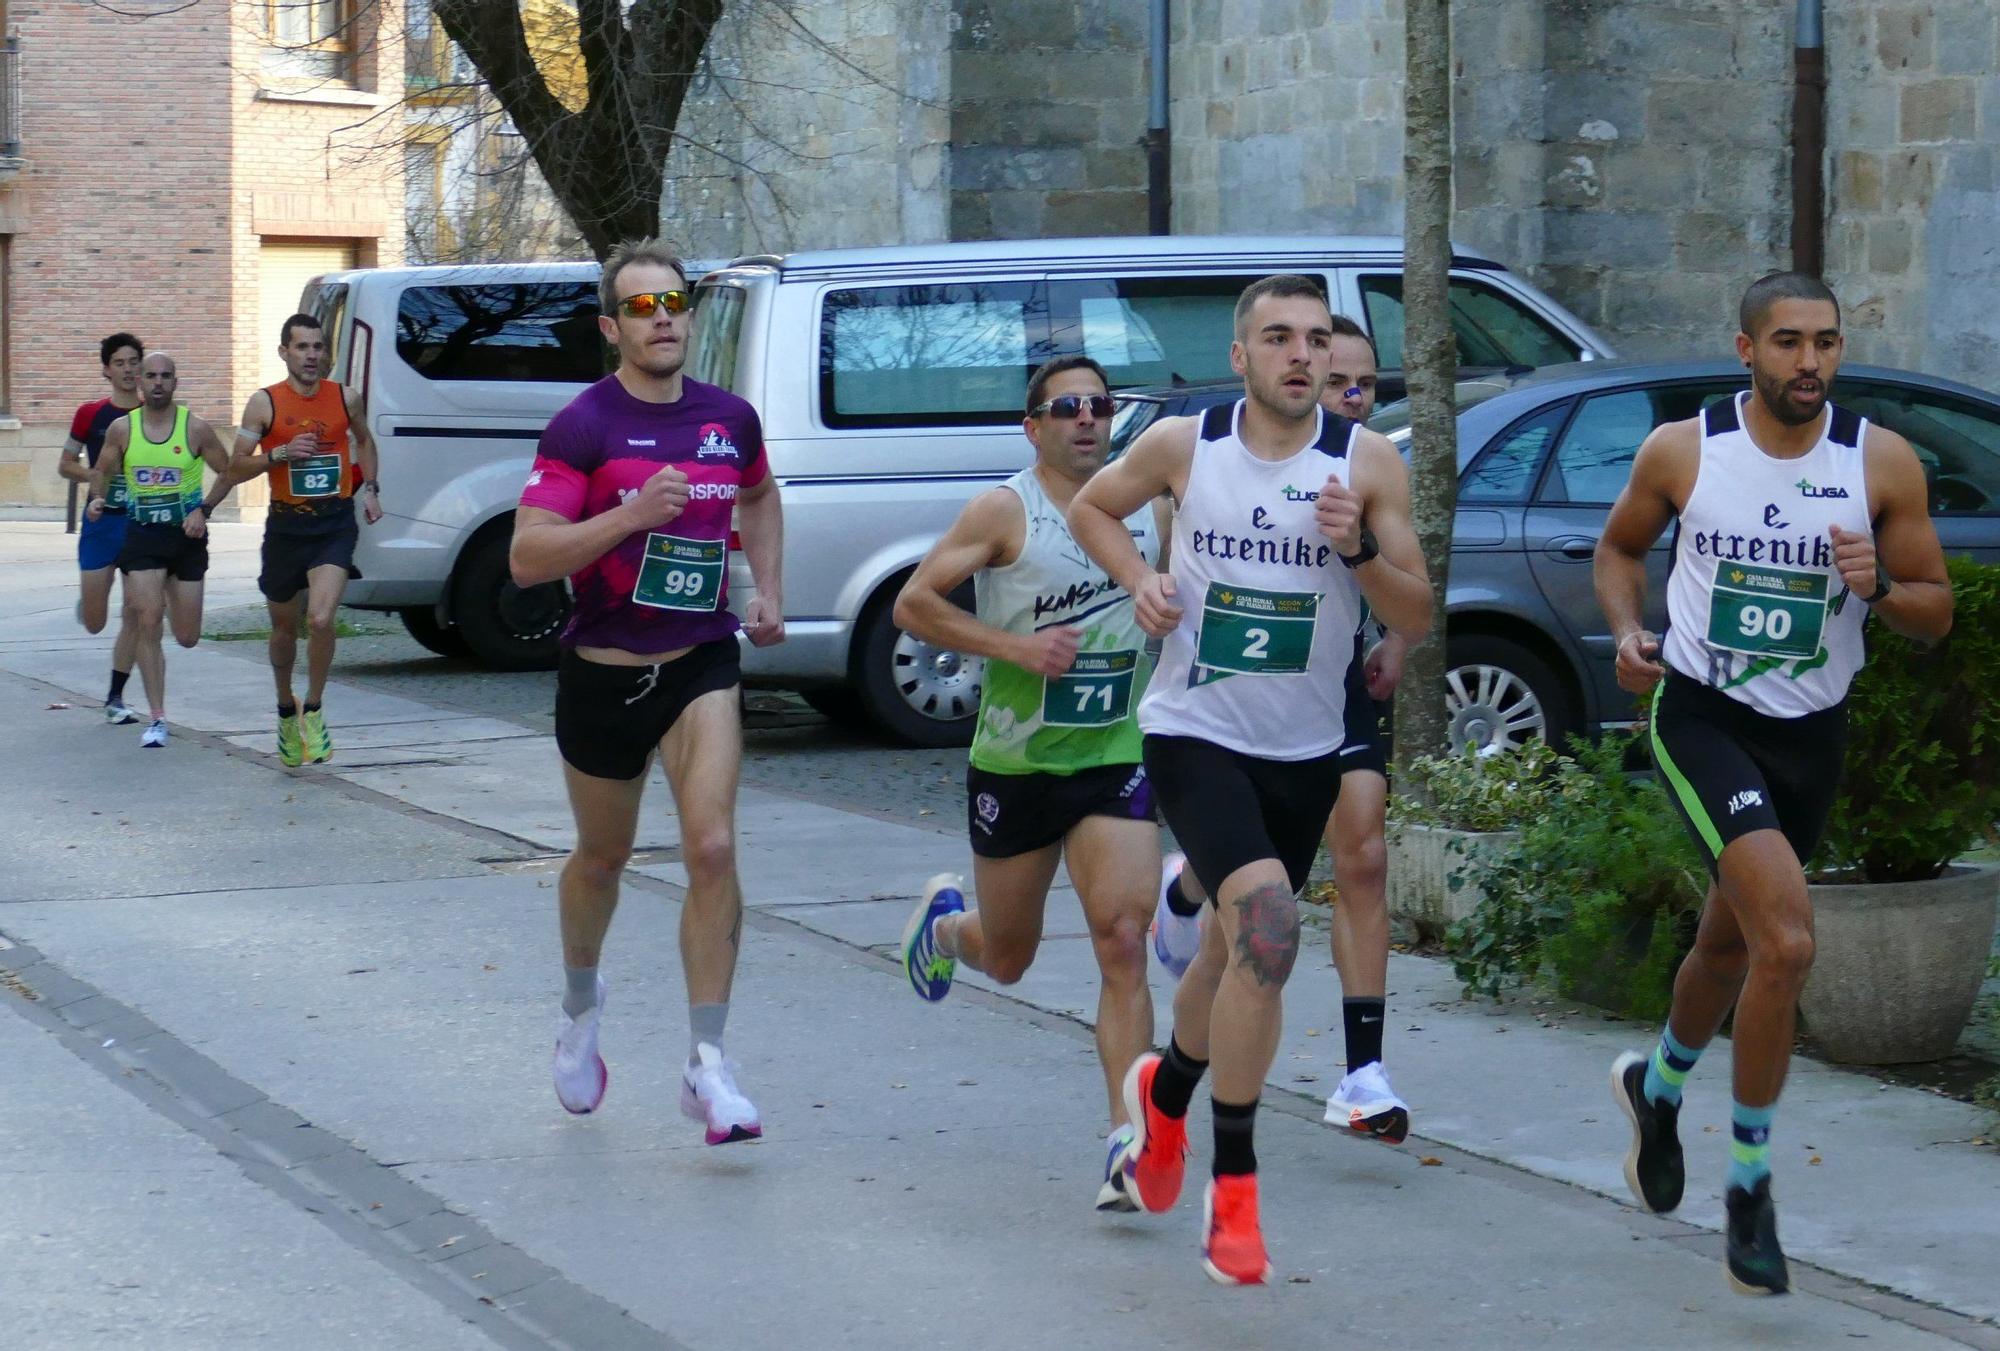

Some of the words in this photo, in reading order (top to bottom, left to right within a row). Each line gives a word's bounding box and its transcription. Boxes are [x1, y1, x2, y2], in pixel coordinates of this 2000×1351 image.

[304, 473, 329, 489] 82
[1801, 486, 1849, 498] LUGA
[1286, 490, 1320, 502] LUG
[148, 509, 172, 523] 78
[1193, 528, 1331, 568] etxenike
[1695, 529, 1833, 568] etxenik
[664, 569, 704, 597] 99
[1236, 595, 1252, 603] CAJA
[1738, 605, 1792, 640] 90
[1241, 627, 1270, 659] 2
[1073, 684, 1113, 712] 71
